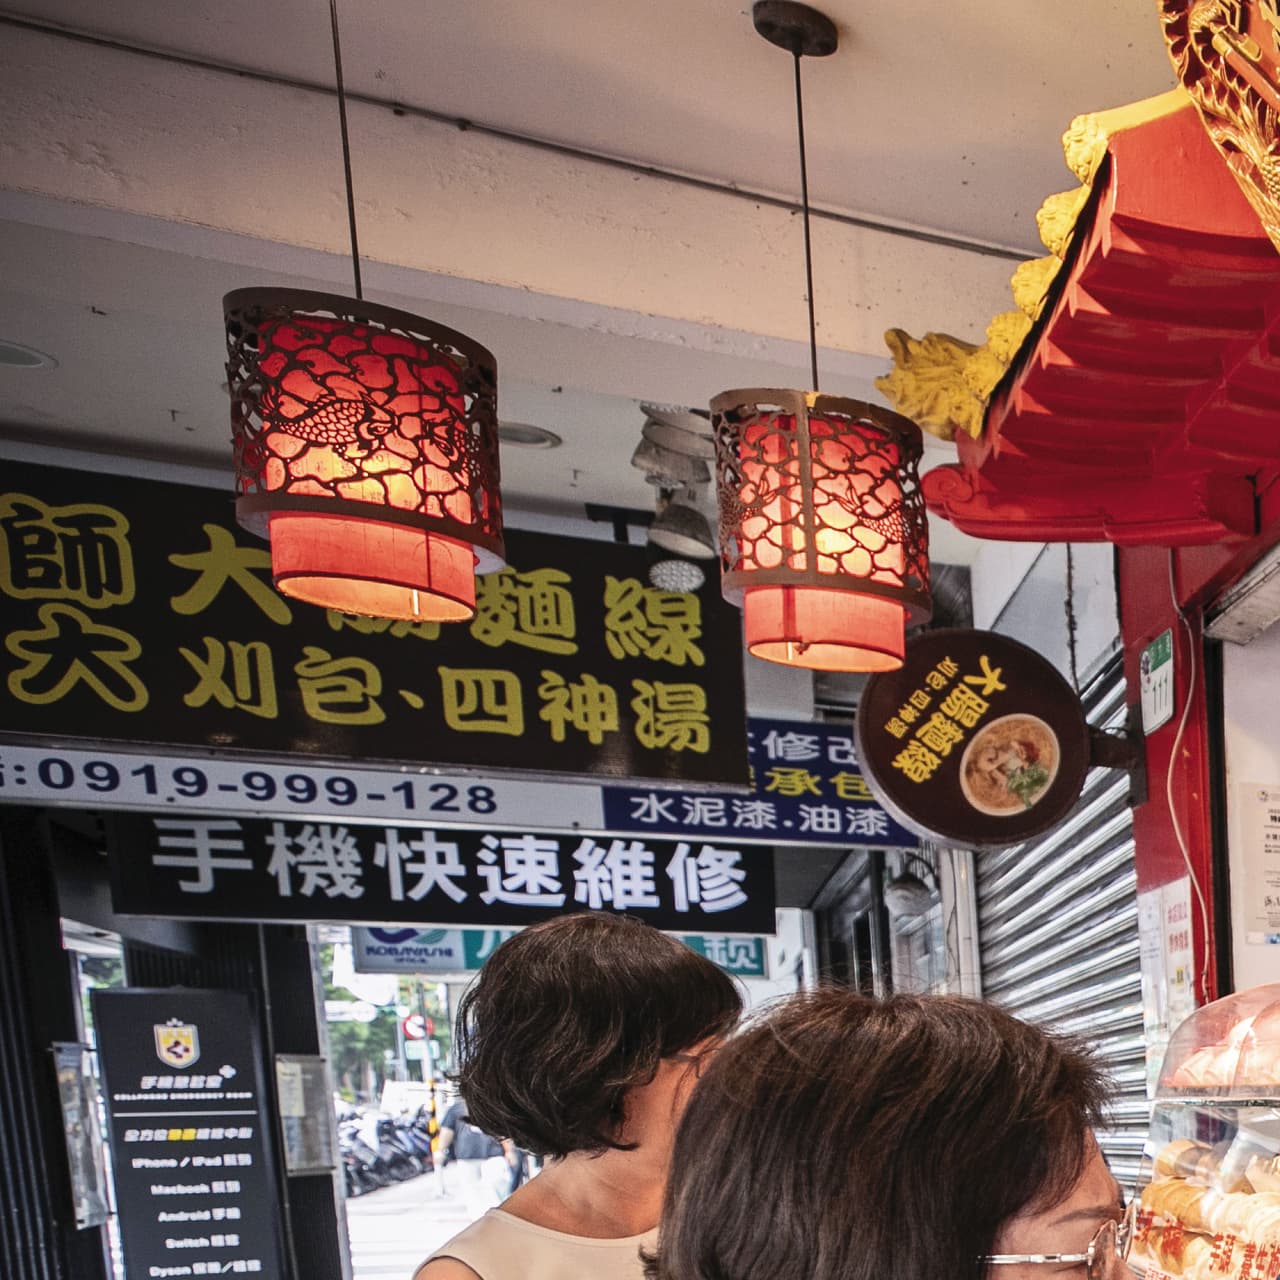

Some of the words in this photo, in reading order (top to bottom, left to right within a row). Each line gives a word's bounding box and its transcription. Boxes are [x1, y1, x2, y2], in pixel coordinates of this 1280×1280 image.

[182, 632, 712, 757] 刈包、四神湯
[891, 655, 1007, 784] 大腸麵線
[0, 757, 498, 815] :0919-999-128
[750, 766, 876, 800] 承包
[152, 817, 749, 914] 手機快速維修
